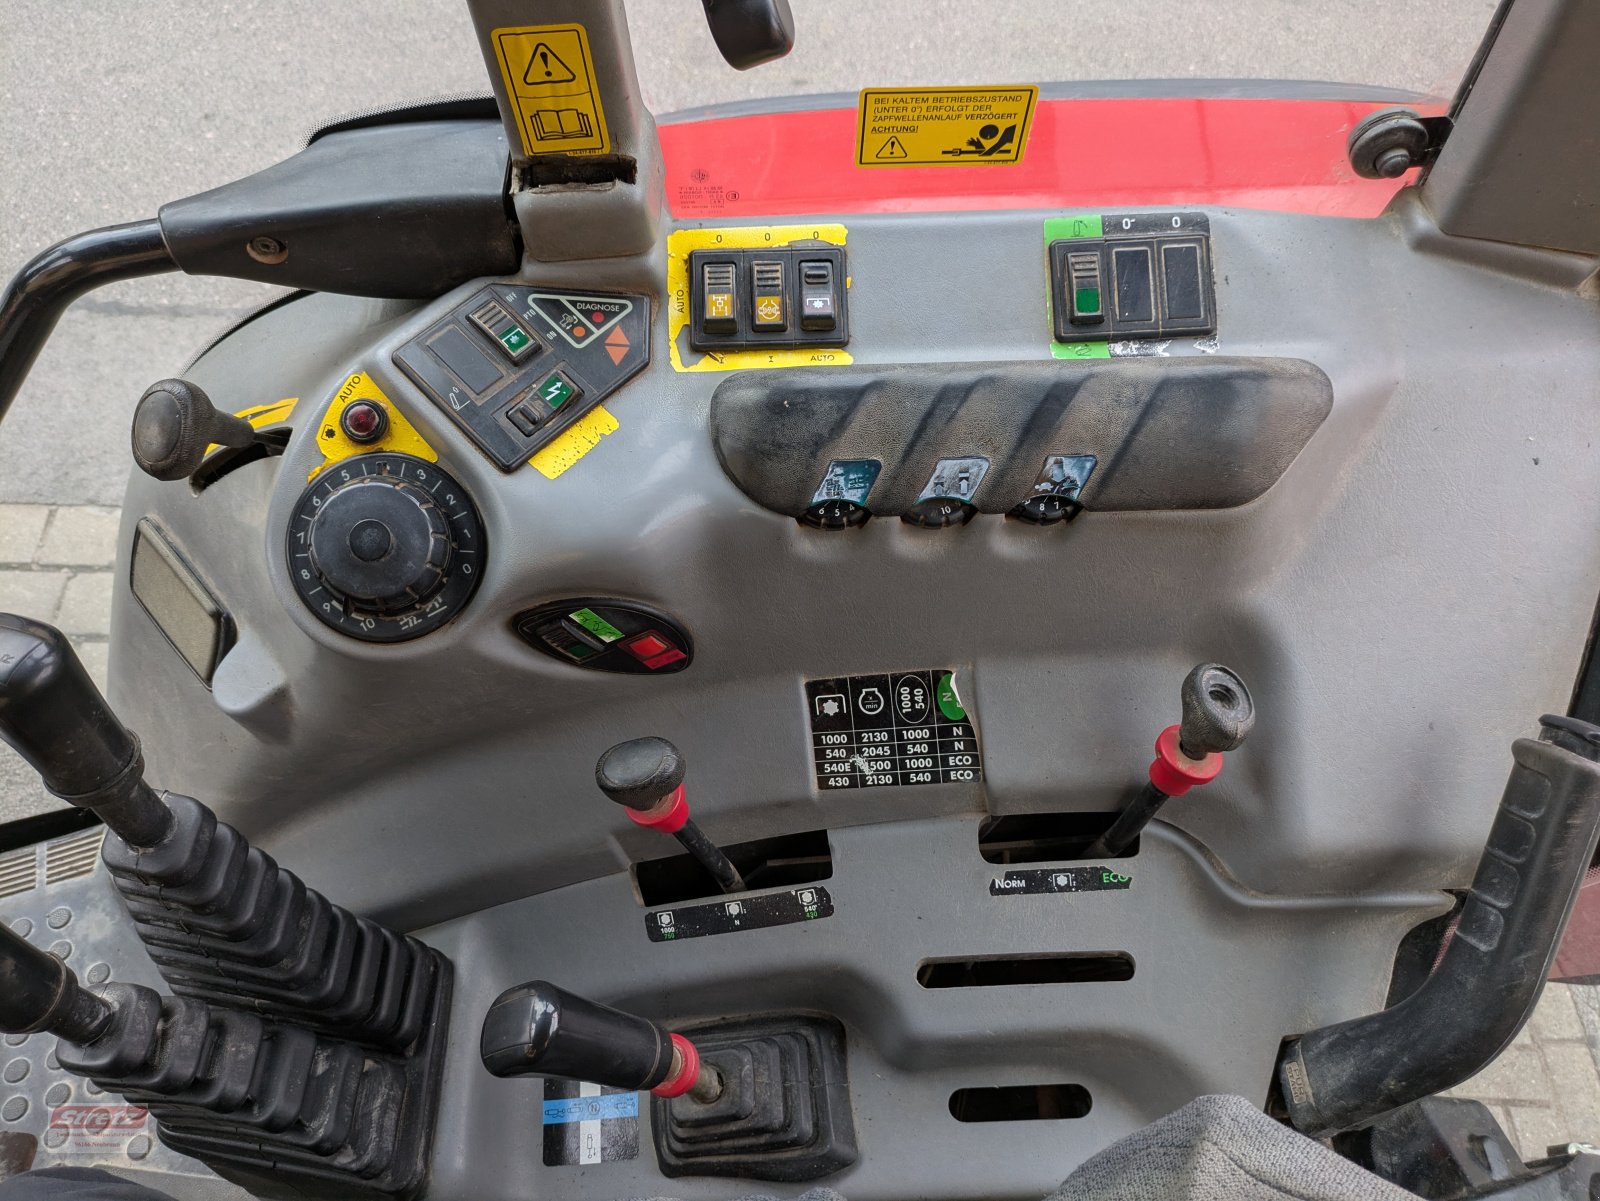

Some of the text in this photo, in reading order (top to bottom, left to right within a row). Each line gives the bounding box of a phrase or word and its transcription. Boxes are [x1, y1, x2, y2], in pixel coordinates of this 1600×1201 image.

[874, 95, 1022, 105] BEI KALTEM BETRIEBSZUSTAND
[873, 106, 908, 114] (UNTER
[911, 105, 923, 114] 0°)
[926, 105, 969, 113] ERFOLGT
[872, 112, 1018, 122] ZAPFWELLENANLAUF VERZÖGERT
[871, 125, 919, 133] ACHTUNG!
[1171, 216, 1180, 228] 0
[716, 234, 723, 243] 0
[764, 232, 771, 241] 0
[813, 231, 819, 240] 0
[576, 302, 620, 312] DIAGNOSE
[523, 308, 537, 320] PTO
[546, 330, 557, 340] ON
[810, 354, 835, 362] AUTO
[339, 375, 361, 403] AUTO
[341, 469, 350, 481] 5
[416, 469, 426, 480] 3
[312, 496, 321, 506] 6
[446, 494, 456, 506] 2
[818, 507, 825, 515] 6
[834, 508, 840, 517] 5
[940, 505, 951, 515] 10
[1039, 503, 1045, 511] 8
[296, 531, 305, 544] 7
[463, 528, 471, 538] 1
[462, 563, 472, 574] 0
[301, 569, 310, 580] 8
[322, 602, 331, 613] 9
[360, 618, 375, 632] 10
[900, 686, 912, 714] 1000
[914, 688, 925, 709] 540
[942, 692, 952, 702] N
[821, 727, 963, 745] 1000 2130 1000 N
[825, 741, 964, 759] 540 2045 540 N
[824, 756, 972, 773] 540E 500 1000 ECO
[828, 770, 974, 787] 430 2130 540 ECO
[1102, 872, 1129, 883] ECO
[994, 878, 1026, 889] NORM
